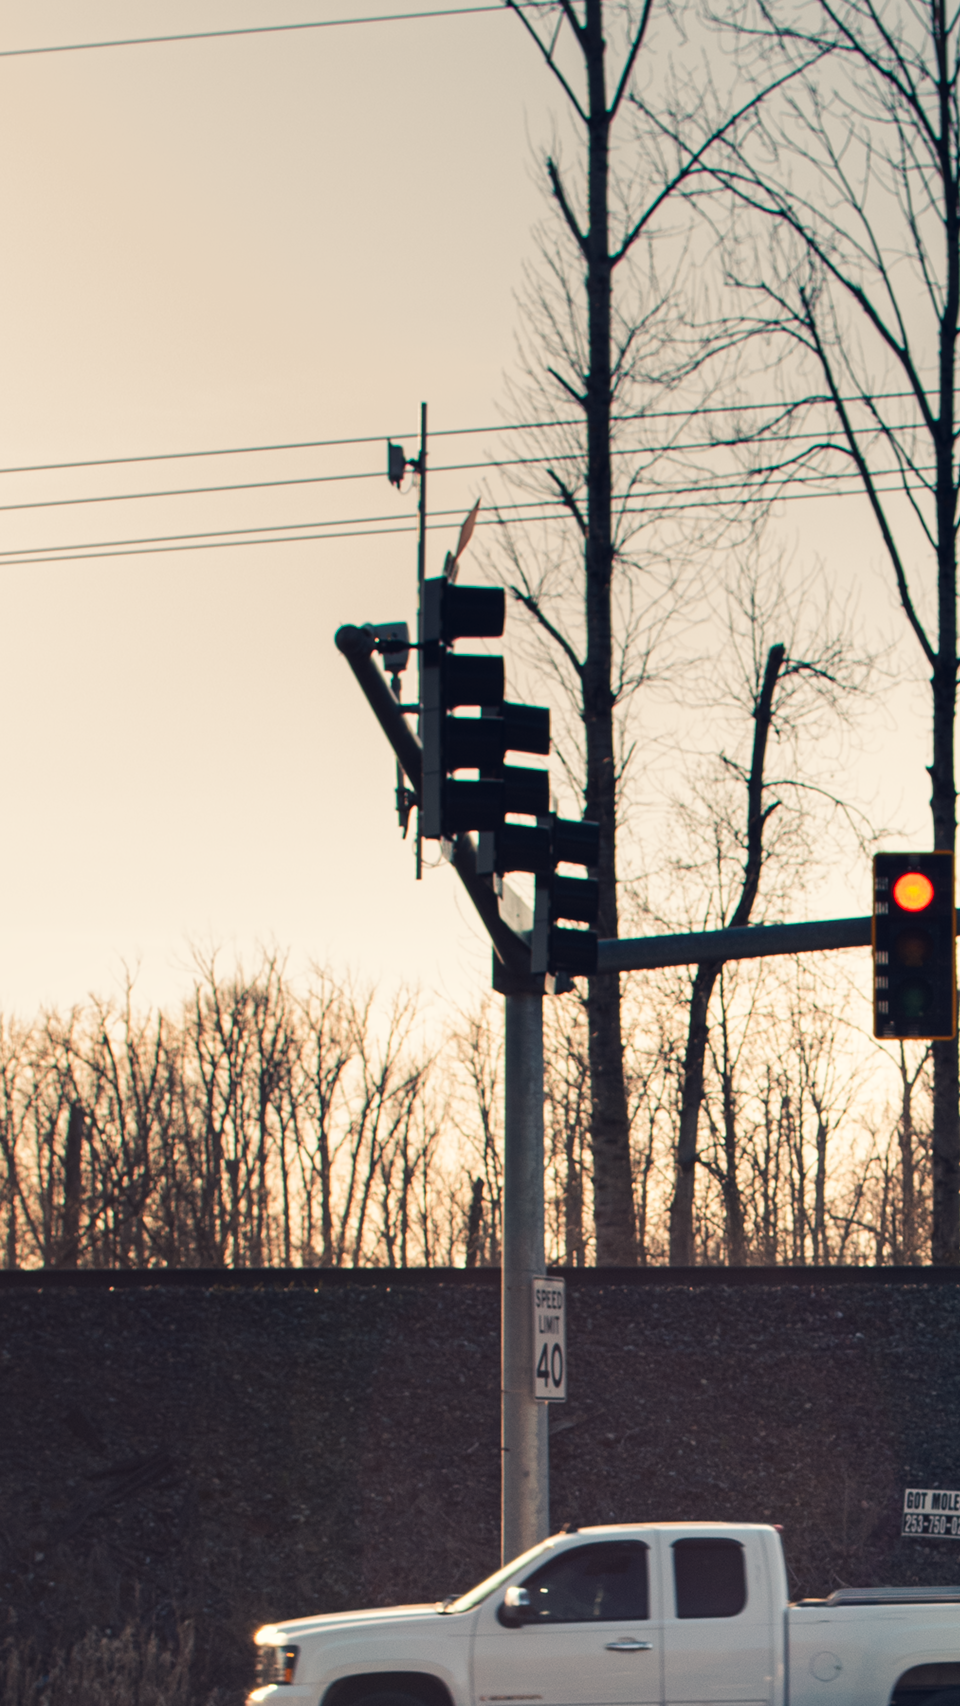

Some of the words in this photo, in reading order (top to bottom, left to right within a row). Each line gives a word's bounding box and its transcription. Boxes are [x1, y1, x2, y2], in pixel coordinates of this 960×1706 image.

[536, 1288, 562, 1309] SPEED
[539, 1315, 560, 1334] LIMIT
[536, 1342, 563, 1388] 40
[906, 1491, 928, 1509] GOT
